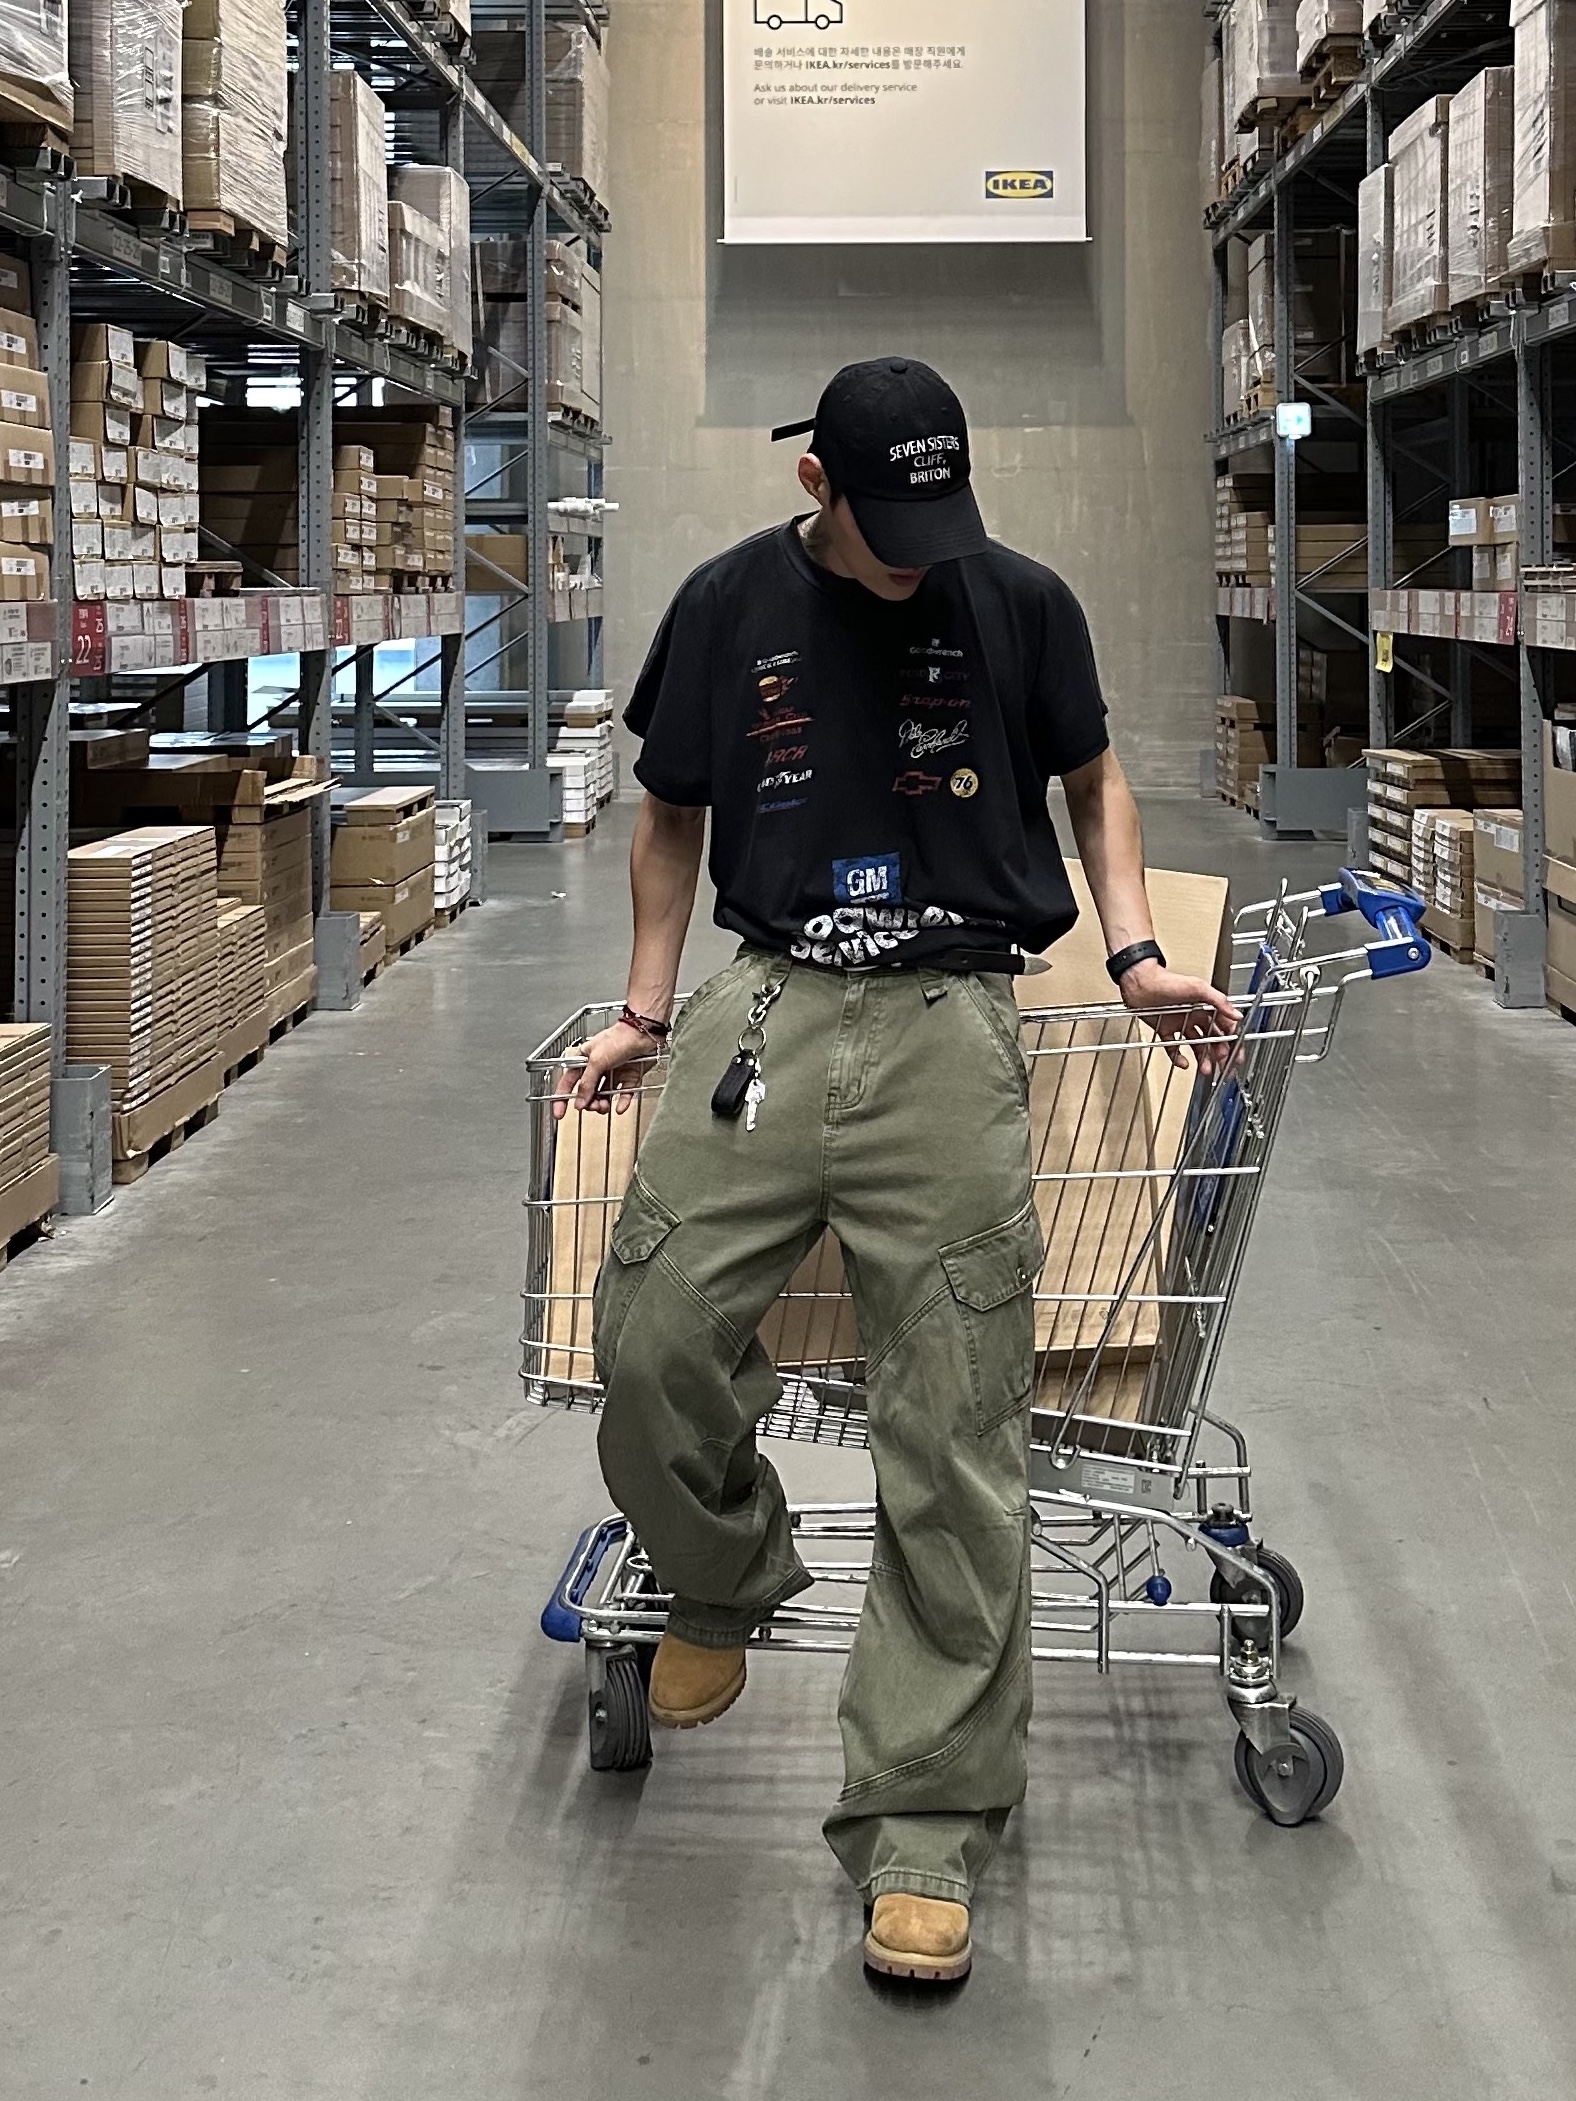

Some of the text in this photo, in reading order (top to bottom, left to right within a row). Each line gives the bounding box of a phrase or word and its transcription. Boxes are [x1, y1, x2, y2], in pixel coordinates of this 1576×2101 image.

[776, 47, 815, 57] 서비스에
[818, 47, 837, 57] 대한
[840, 46, 869, 57] 자세한
[872, 46, 901, 57] 내용은
[904, 46, 923, 57] 매장
[754, 60, 802, 70] 문의하거나
[754, 83, 772, 92] Ask
[789, 83, 818, 92] about
[840, 83, 880, 94] delivery
[882, 83, 918, 92] service
[767, 96, 787, 105] visit
[790, 95, 876, 105] IKEA.kr/services
[992, 179, 1048, 190] IKEA
[889, 435, 960, 462] SEVEN SISTERS
[909, 465, 951, 484] BRITON
[76, 634, 92, 665] 22
[954, 775, 973, 790] 76
[846, 865, 889, 897] GM
